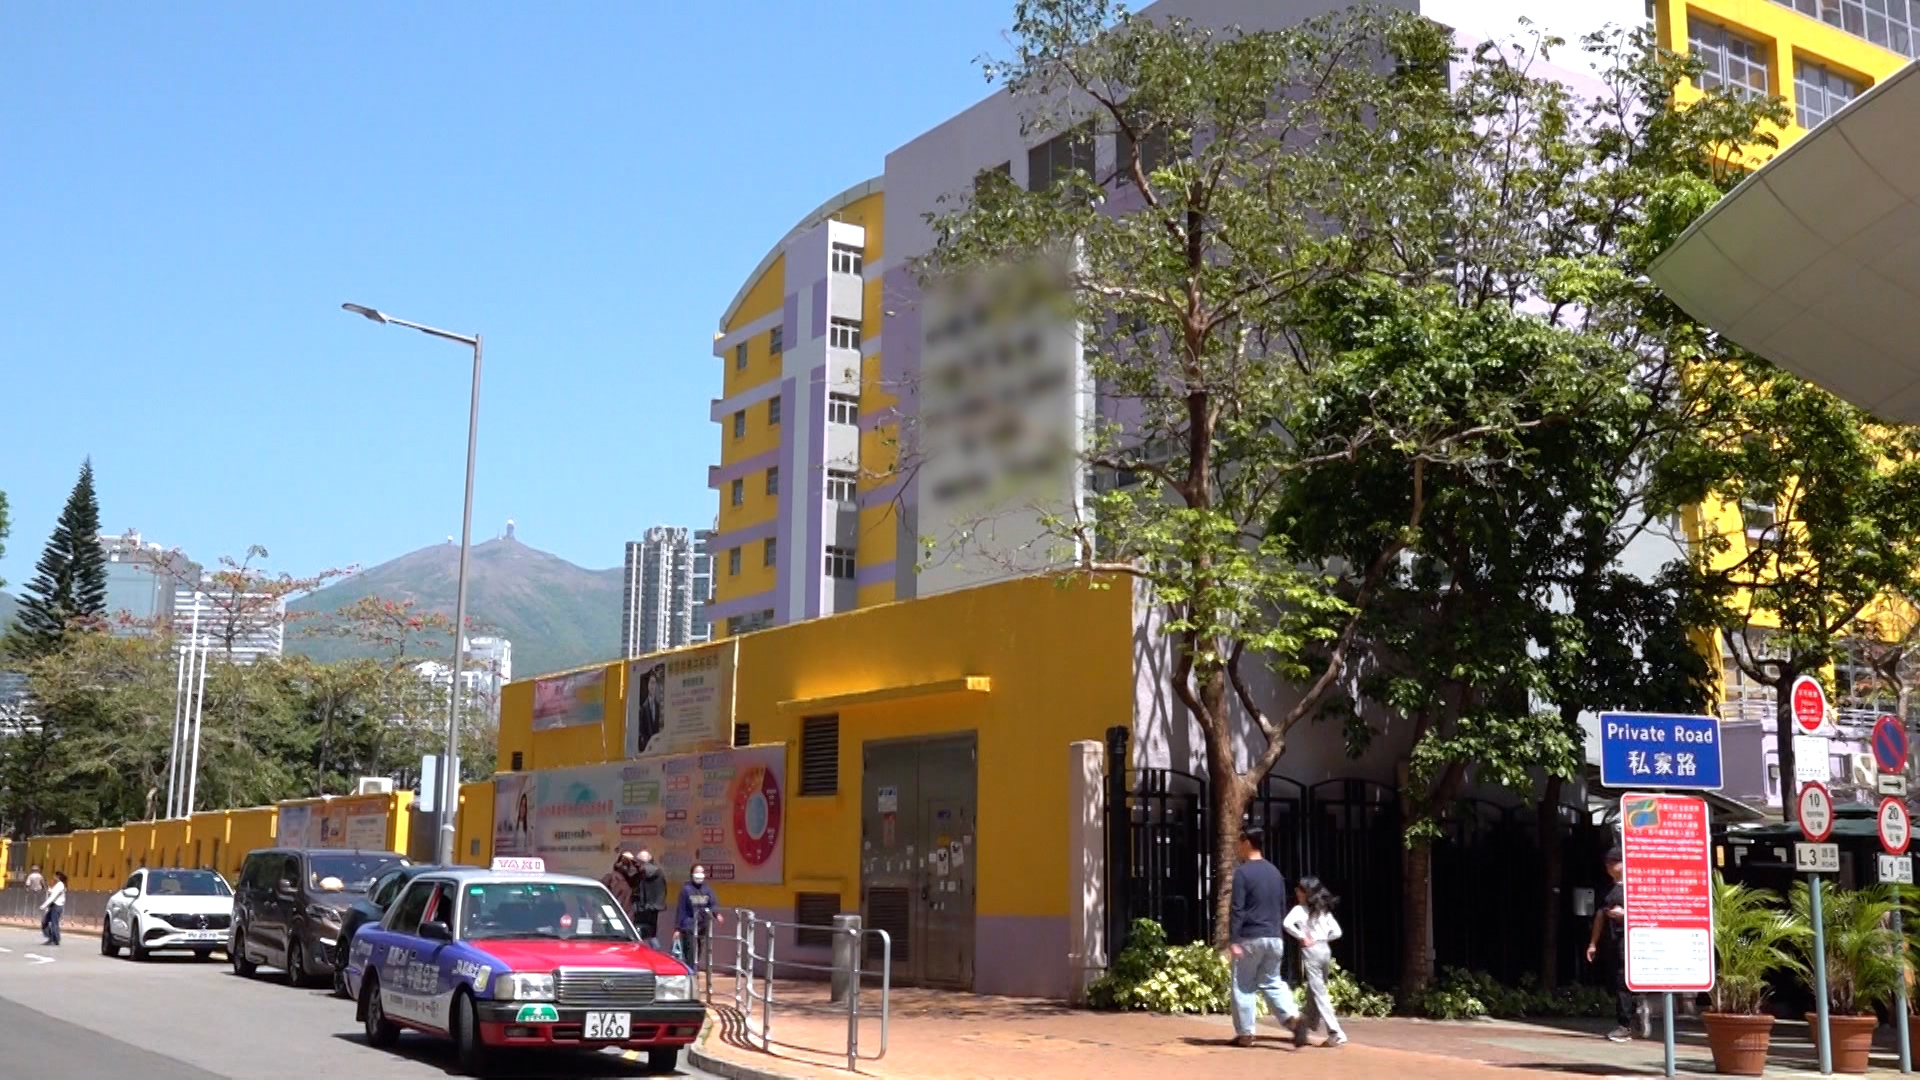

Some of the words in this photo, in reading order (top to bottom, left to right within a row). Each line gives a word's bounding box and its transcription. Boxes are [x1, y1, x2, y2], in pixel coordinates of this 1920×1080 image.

[1607, 722, 1665, 742] Private
[1674, 725, 1713, 744] Road
[1628, 750, 1697, 776] 私家路
[1809, 793, 1820, 807] 10
[1888, 805, 1899, 820] 20
[498, 859, 541, 870] TAXI
[599, 1012, 617, 1025] YA
[590, 1023, 625, 1037] 5160
